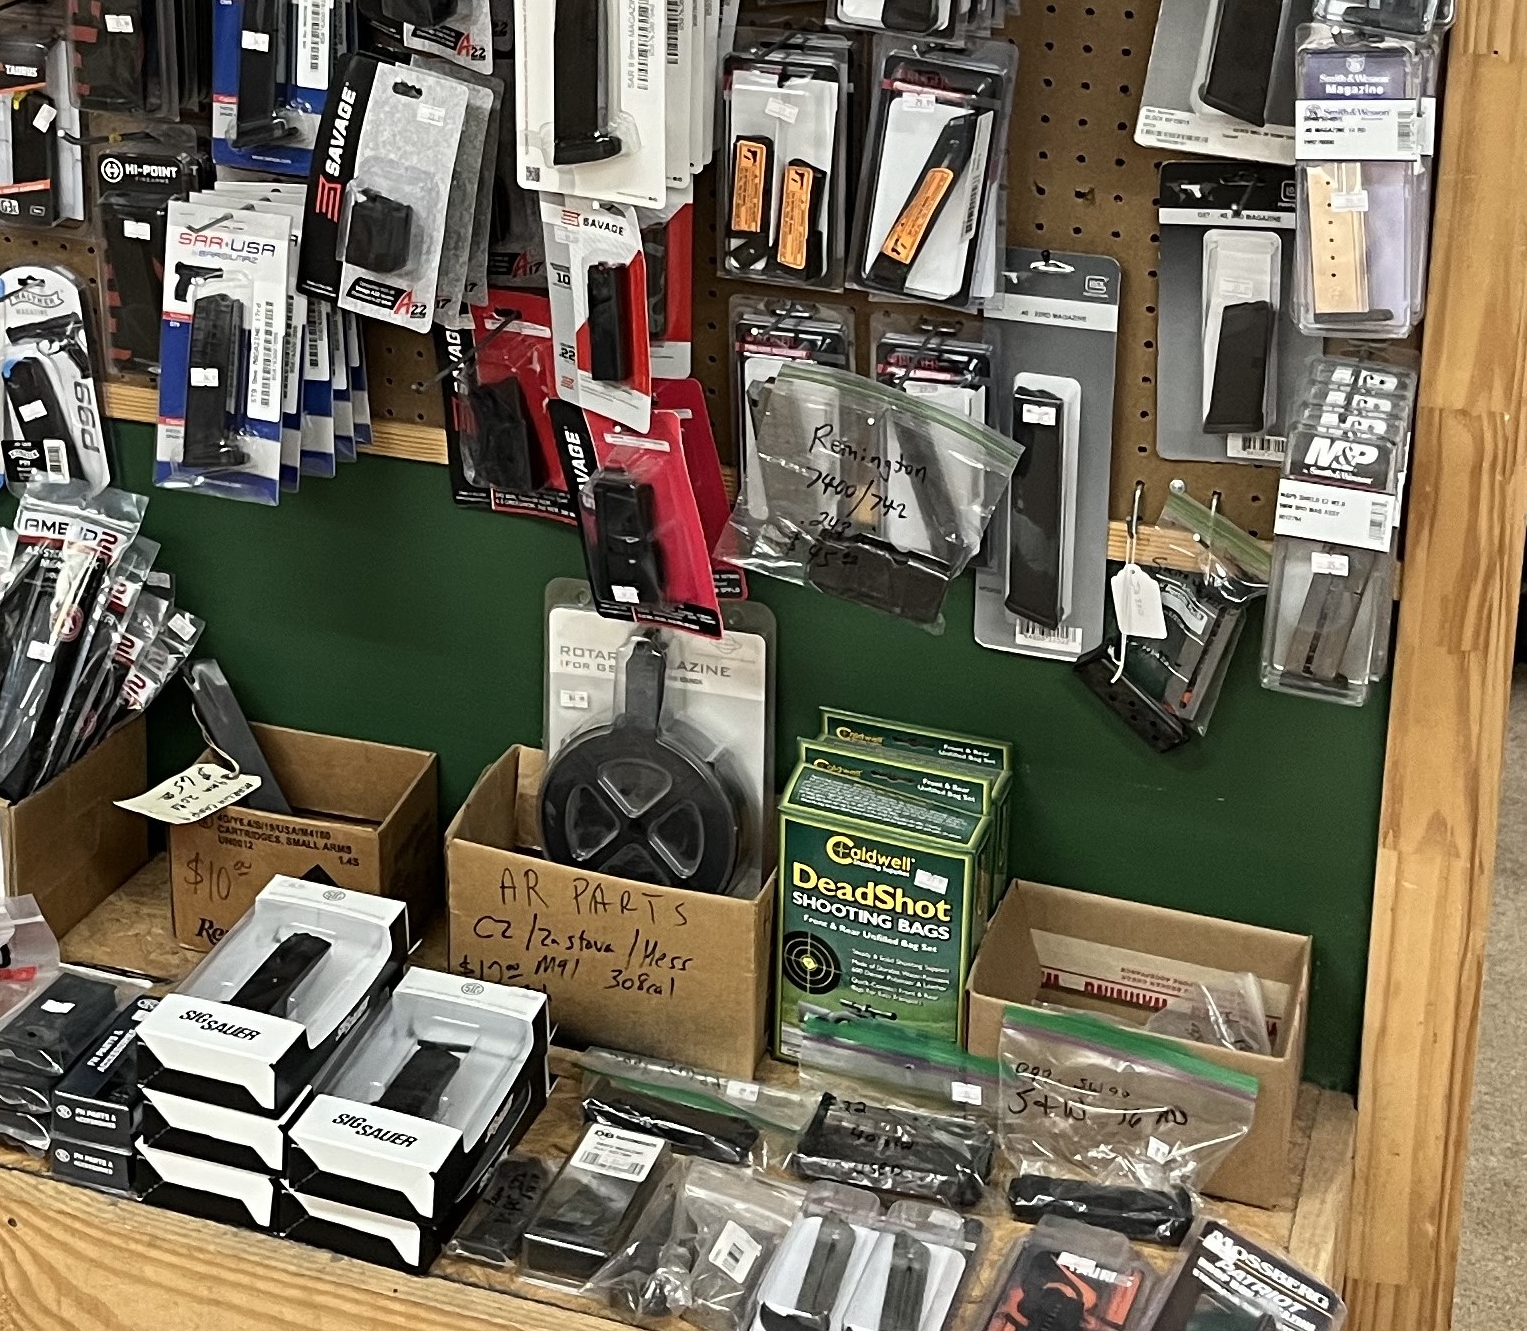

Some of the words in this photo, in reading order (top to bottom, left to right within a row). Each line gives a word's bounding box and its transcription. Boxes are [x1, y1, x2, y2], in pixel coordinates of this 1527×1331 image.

[1325, 84, 1386, 96] Magazine
[326, 85, 358, 177] SAVAGE
[124, 163, 178, 179] HI-POINT
[582, 216, 625, 237] SAVAGE
[556, 272, 571, 287] 10
[12, 289, 60, 309] WALTHER
[252, 327, 261, 367] MAGAZINE
[72, 379, 102, 454] P99
[808, 423, 928, 485] Remington
[1304, 436, 1379, 471] M&P
[560, 645, 619, 663] ROTAR
[286, 837, 320, 852] SMALL
[322, 840, 352, 855] ARMS
[825, 835, 916, 872] Caldwell
[499, 868, 550, 909] AR
[573, 878, 689, 927] PARTS
[792, 861, 952, 922] DeadShot
[792, 891, 893, 929] SHOOTING
[897, 918, 951, 941] BAGS
[803, 914, 828, 929] Front
[839, 924, 861, 937] Rear
[862, 929, 900, 946] Unfilled
[900, 940, 920, 952] Bag
[921, 943, 938, 954] Set
[180, 1007, 207, 1025] SIG
[201, 1018, 261, 1043] SAUER
[332, 1112, 362, 1132] SIG
[357, 1122, 418, 1150] SAUER
[1202, 1230, 1330, 1310] MOSSBERG
[1214, 1259, 1307, 1313] PATRIOT
